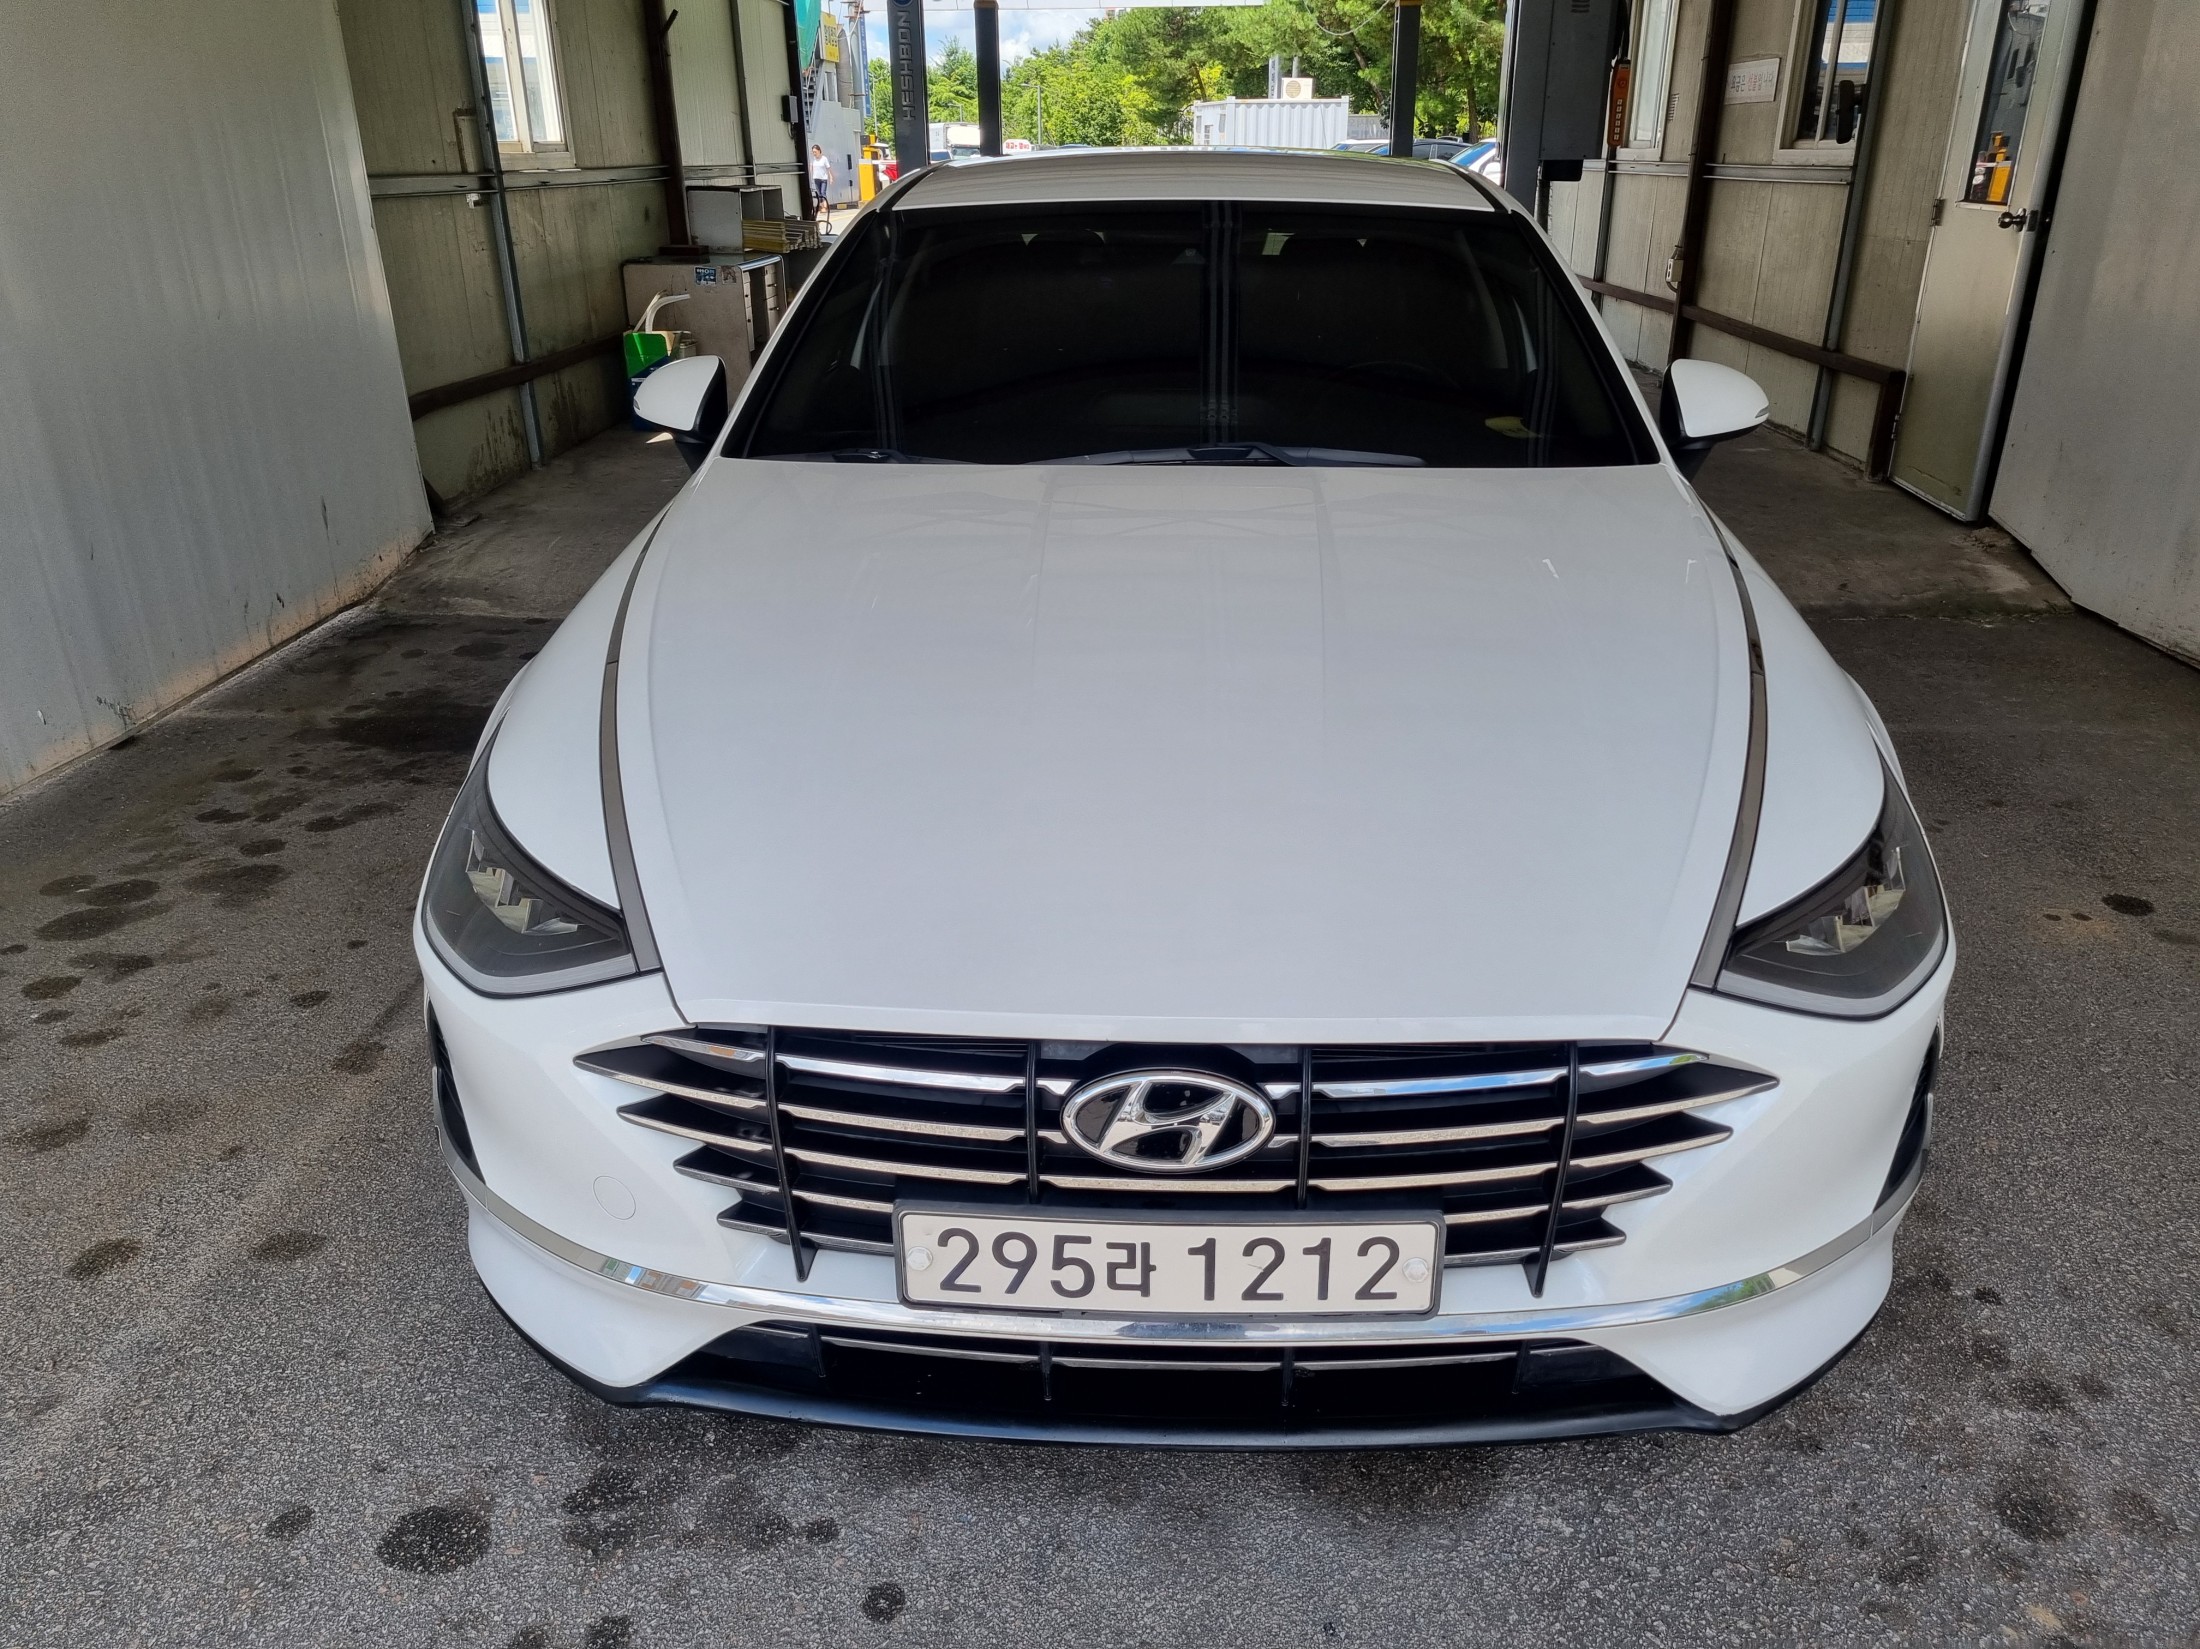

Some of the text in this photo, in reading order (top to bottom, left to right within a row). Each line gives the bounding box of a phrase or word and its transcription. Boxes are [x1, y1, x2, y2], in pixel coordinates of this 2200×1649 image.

[897, 10, 916, 121] HESHBON
[937, 1227, 1401, 1301] 295라 1212
